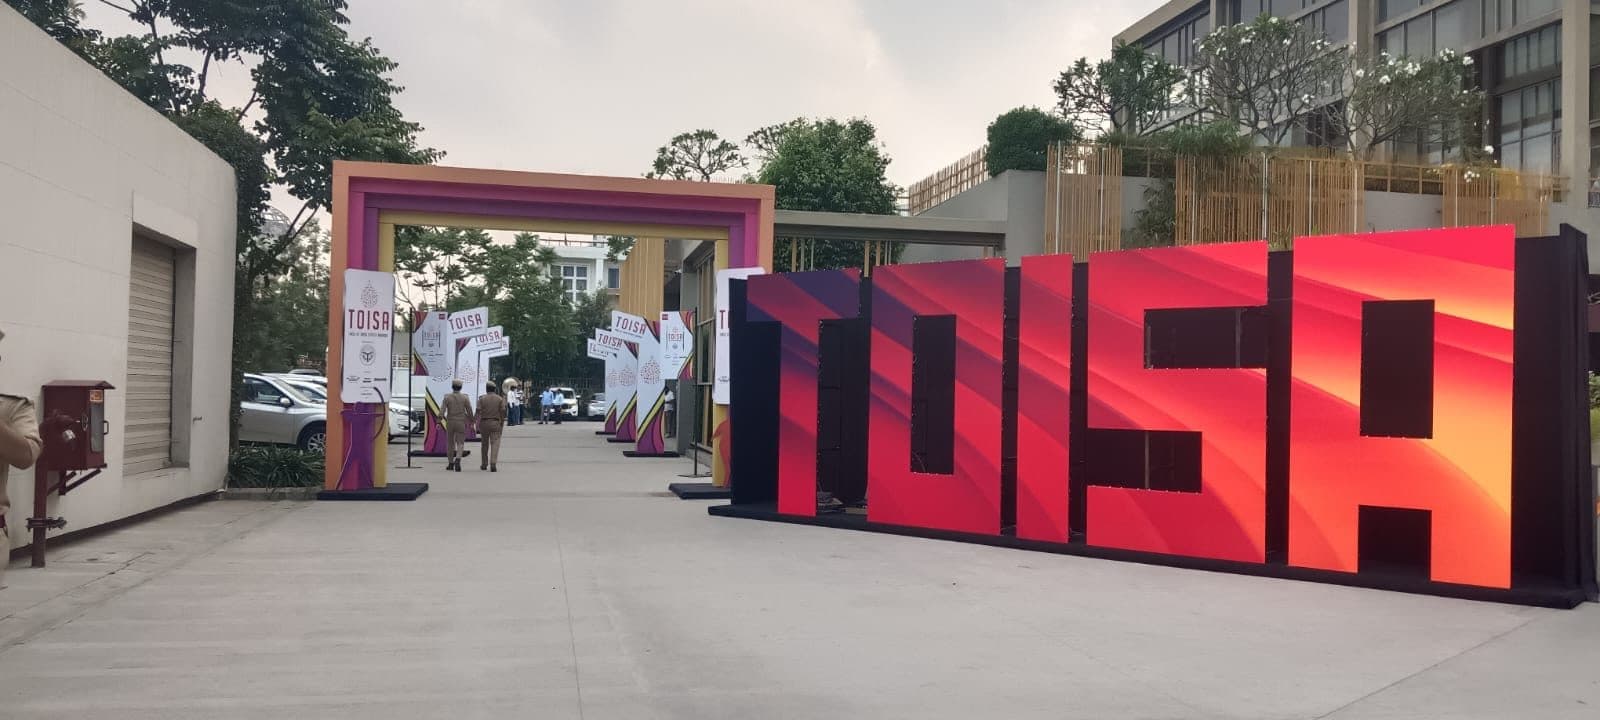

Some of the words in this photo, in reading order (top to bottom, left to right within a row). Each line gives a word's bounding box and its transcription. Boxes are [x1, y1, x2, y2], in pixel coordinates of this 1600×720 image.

[348, 309, 390, 331] TOISA
[449, 313, 482, 330] TOISA
[616, 316, 646, 334] TOISA
[475, 330, 501, 343] TOISA
[598, 333, 622, 347] TOISA
[747, 225, 1516, 588] TOISA
